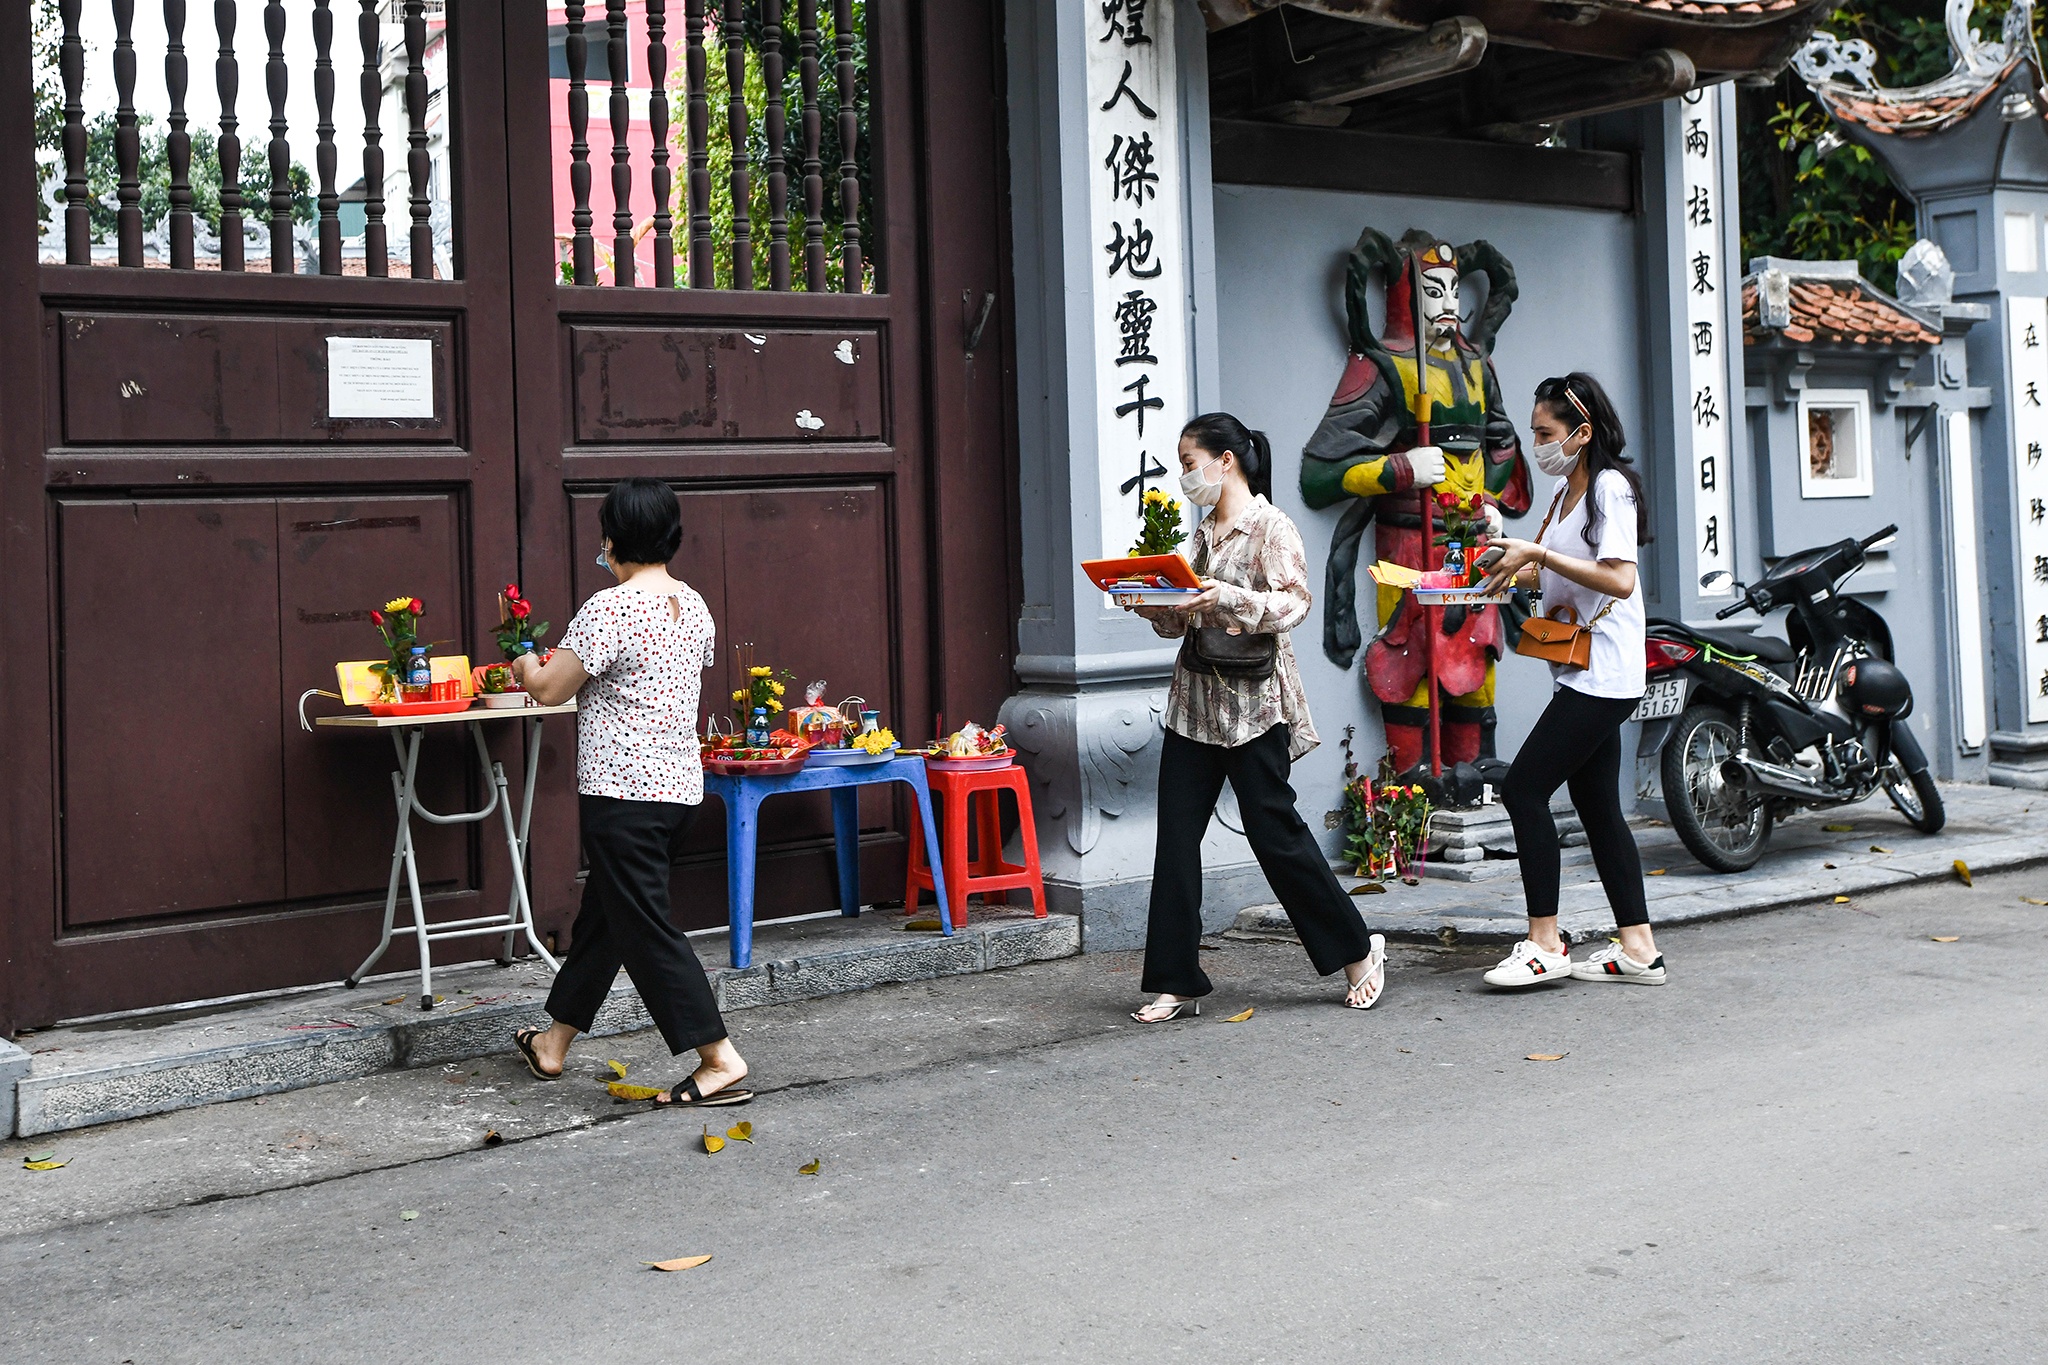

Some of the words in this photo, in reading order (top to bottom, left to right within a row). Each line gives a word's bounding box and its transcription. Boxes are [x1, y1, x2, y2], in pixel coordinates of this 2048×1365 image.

[1683, 87, 1720, 558] 兩柱東西依日月
[1642, 681, 1678, 701] 9-L5
[1636, 697, 1680, 719] 151.67
